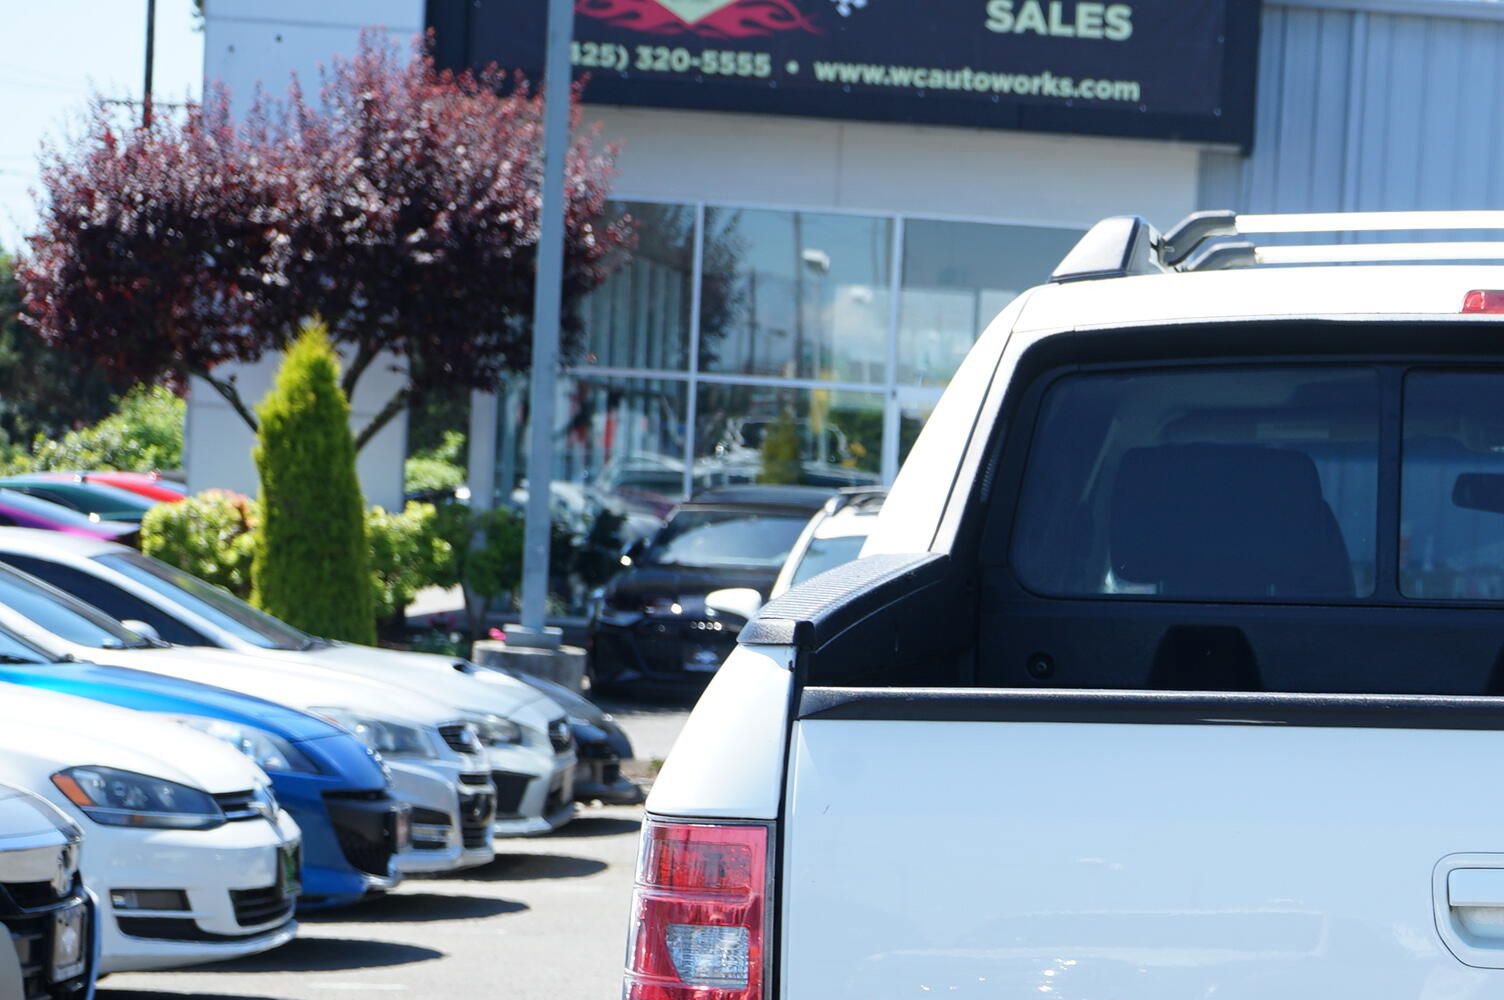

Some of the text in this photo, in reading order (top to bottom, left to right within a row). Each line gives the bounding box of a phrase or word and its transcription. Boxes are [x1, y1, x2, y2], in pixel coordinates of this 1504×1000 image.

[984, 0, 1134, 41] SALES
[634, 44, 772, 78] 320-5555
[813, 60, 1142, 102] www.wcautoworks.com
